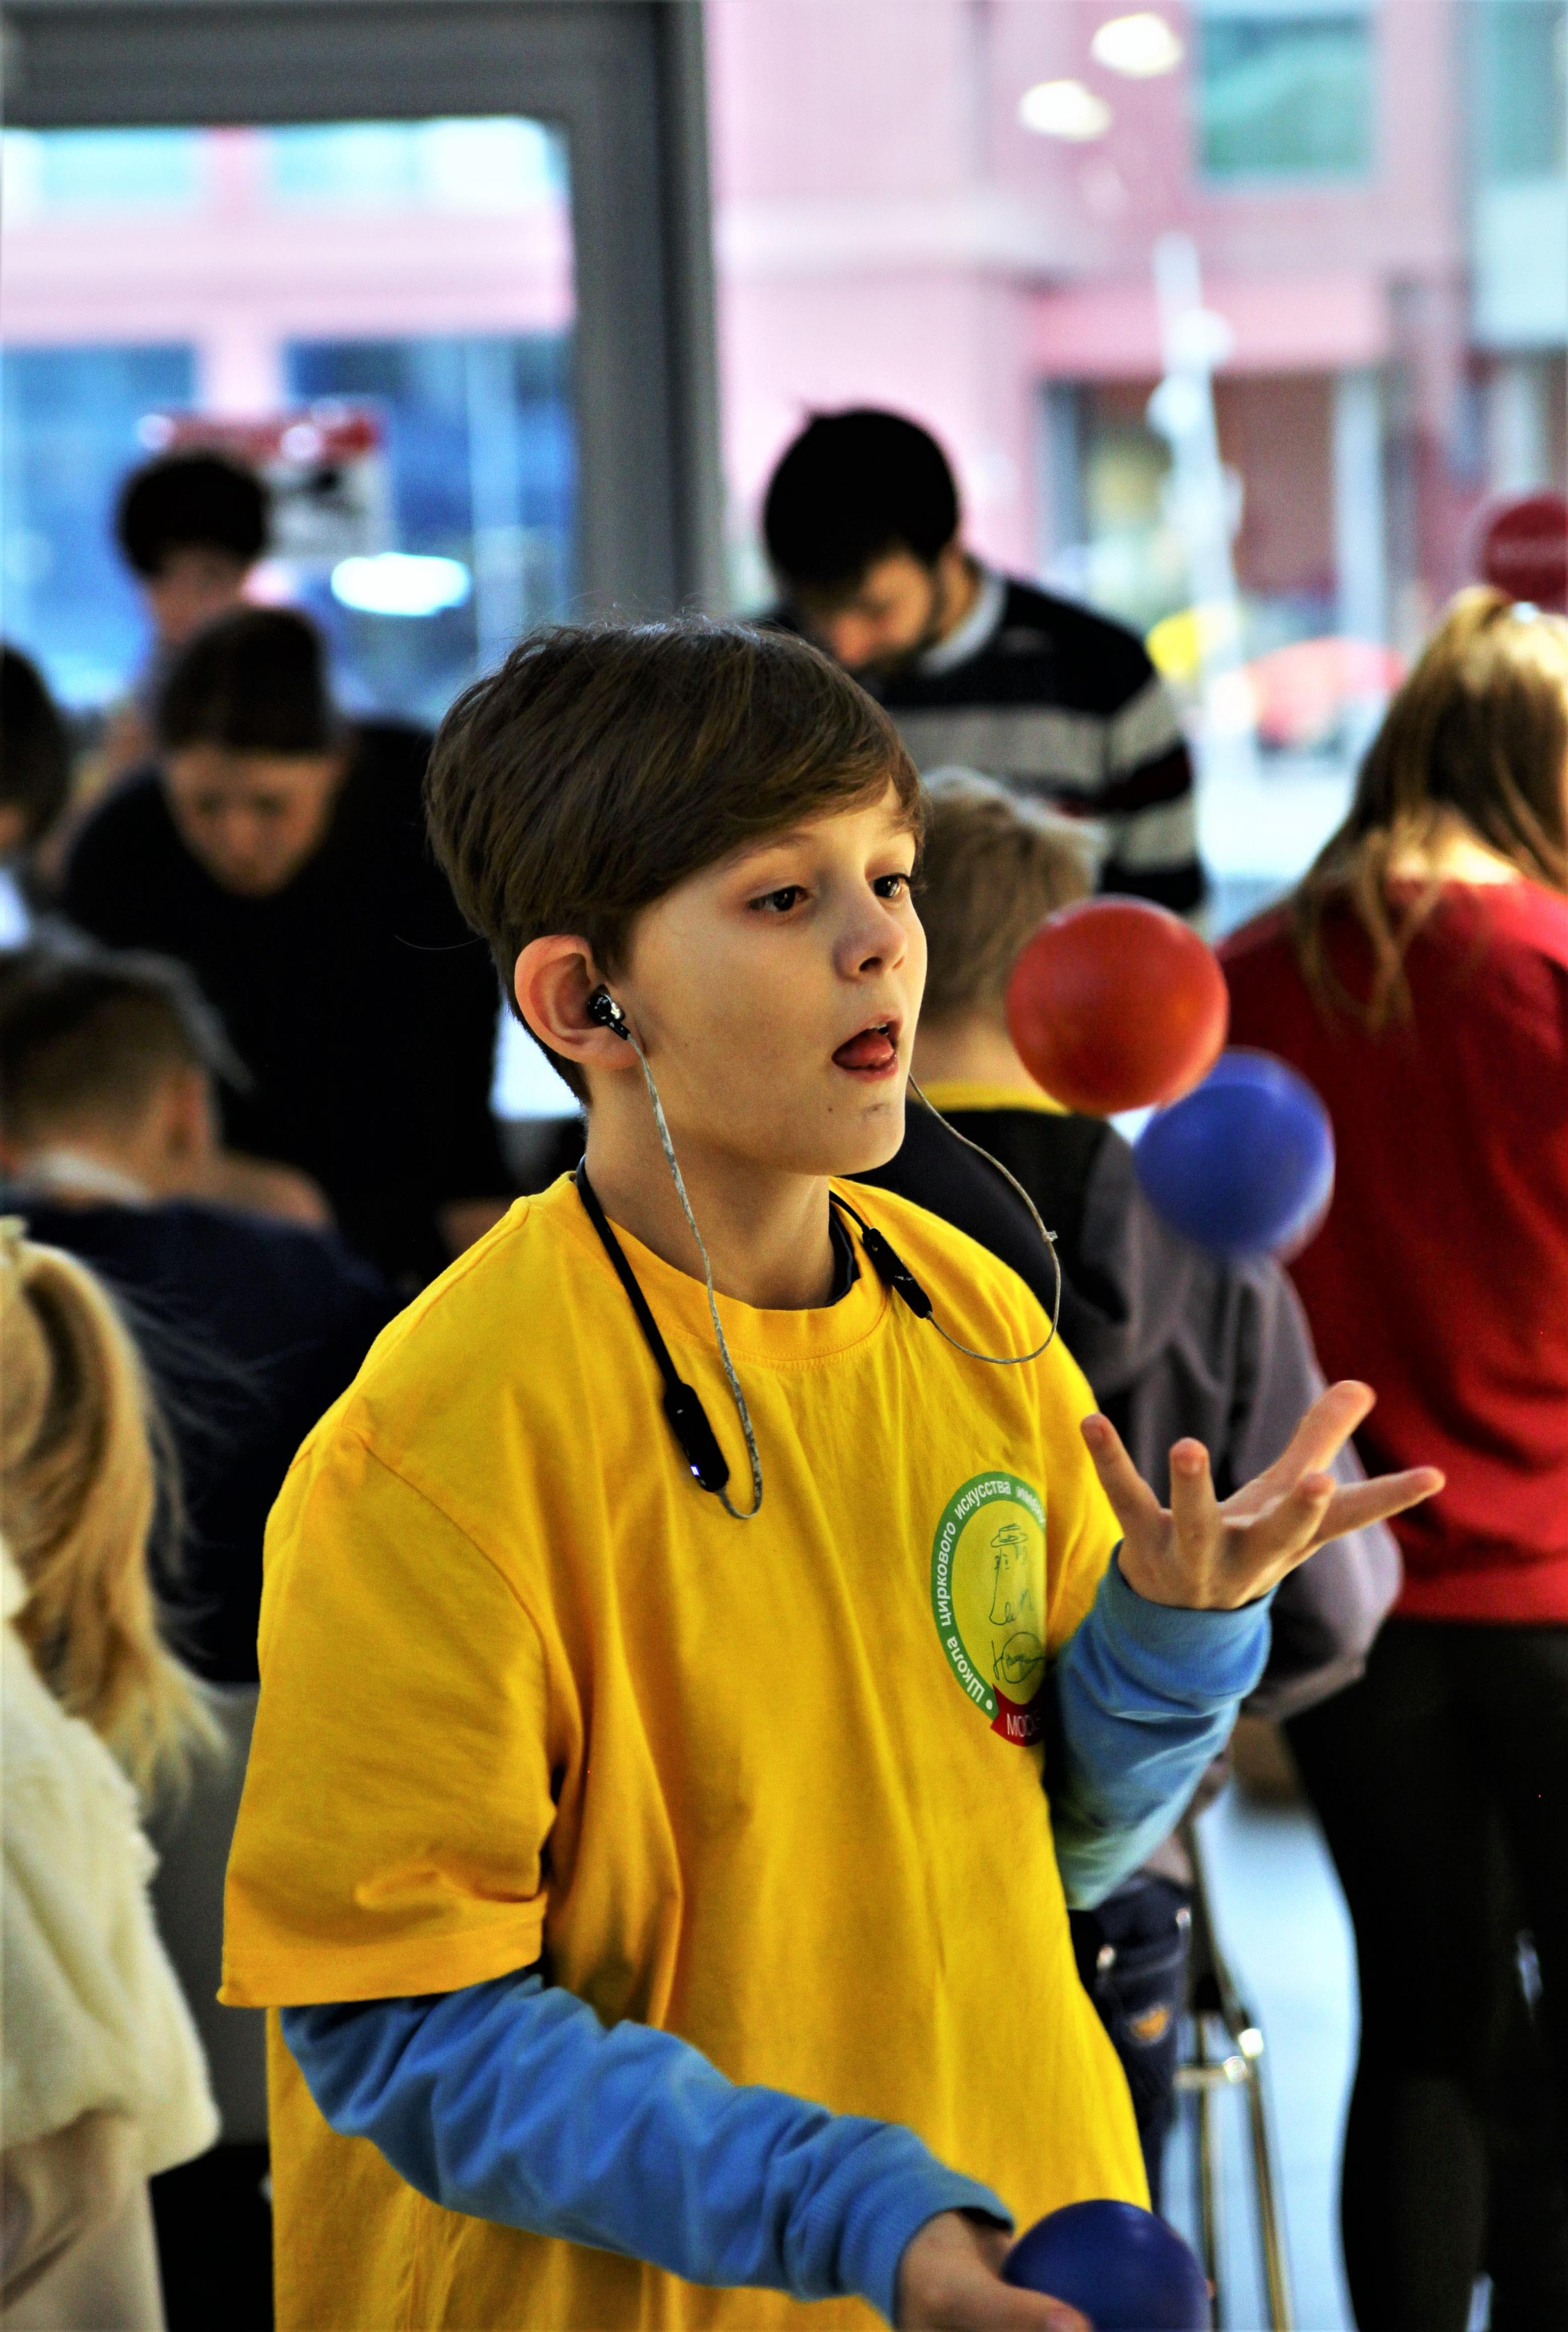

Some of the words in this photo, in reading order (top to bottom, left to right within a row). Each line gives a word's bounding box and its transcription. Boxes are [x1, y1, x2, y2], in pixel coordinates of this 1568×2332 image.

[954, 1480, 1012, 1520] искусства
[937, 1522, 956, 1626] циркового
[947, 1636, 985, 1703] Школа
